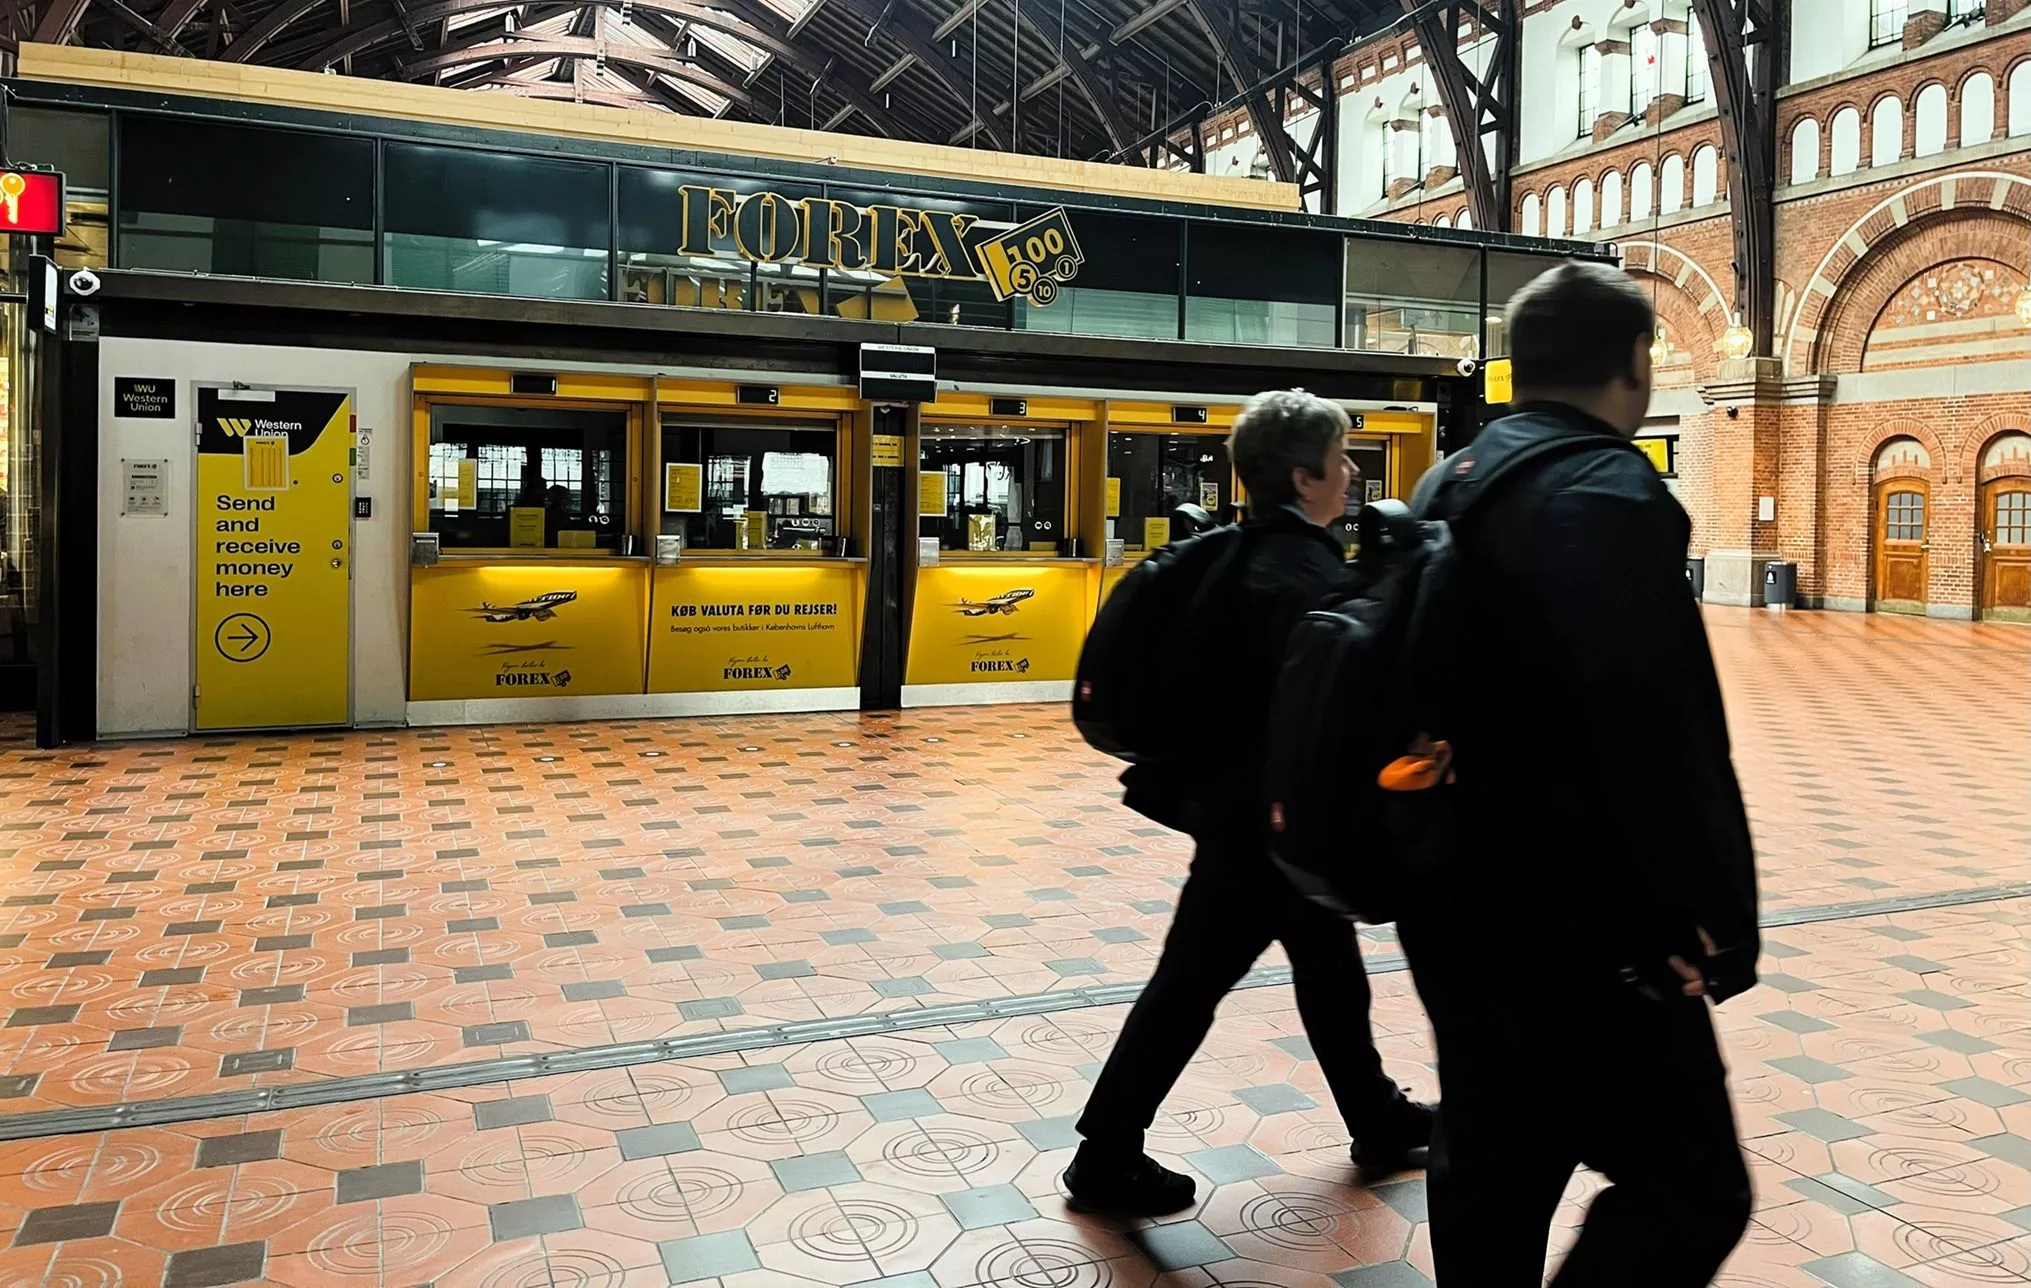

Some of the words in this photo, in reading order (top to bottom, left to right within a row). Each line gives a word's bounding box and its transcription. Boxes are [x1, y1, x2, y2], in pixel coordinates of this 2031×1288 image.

[677, 185, 983, 280] FOREX
[1007, 228, 1064, 264] 100
[1064, 262, 1070, 275] 1
[1017, 269, 1031, 288] 5
[1038, 285, 1051, 297] 10
[123, 393, 168, 404] Western
[768, 389, 777, 402] 2
[130, 402, 161, 412] Union
[1019, 402, 1026, 414] 3
[1198, 410, 1206, 421] 4
[1356, 416, 1363, 428] 5
[255, 419, 302, 430] Western
[216, 494, 275, 511] Send
[216, 517, 259, 532] and
[216, 539, 300, 554] receive
[216, 562, 293, 578] money
[216, 581, 268, 597] here
[671, 604, 697, 617] KØB
[701, 604, 744, 617] VALUTA
[748, 603, 771, 616] FØR
[775, 603, 790, 616] DU
[794, 603, 837, 615] REJSER!
[671, 624, 692, 634] Besøg
[732, 622, 759, 632] butikker
[765, 622, 806, 631] Københavns
[807, 621, 835, 630] Lufthavn
[971, 660, 1014, 672] FOREX
[496, 672, 550, 686] FOREX
[723, 667, 772, 680] FOREX
